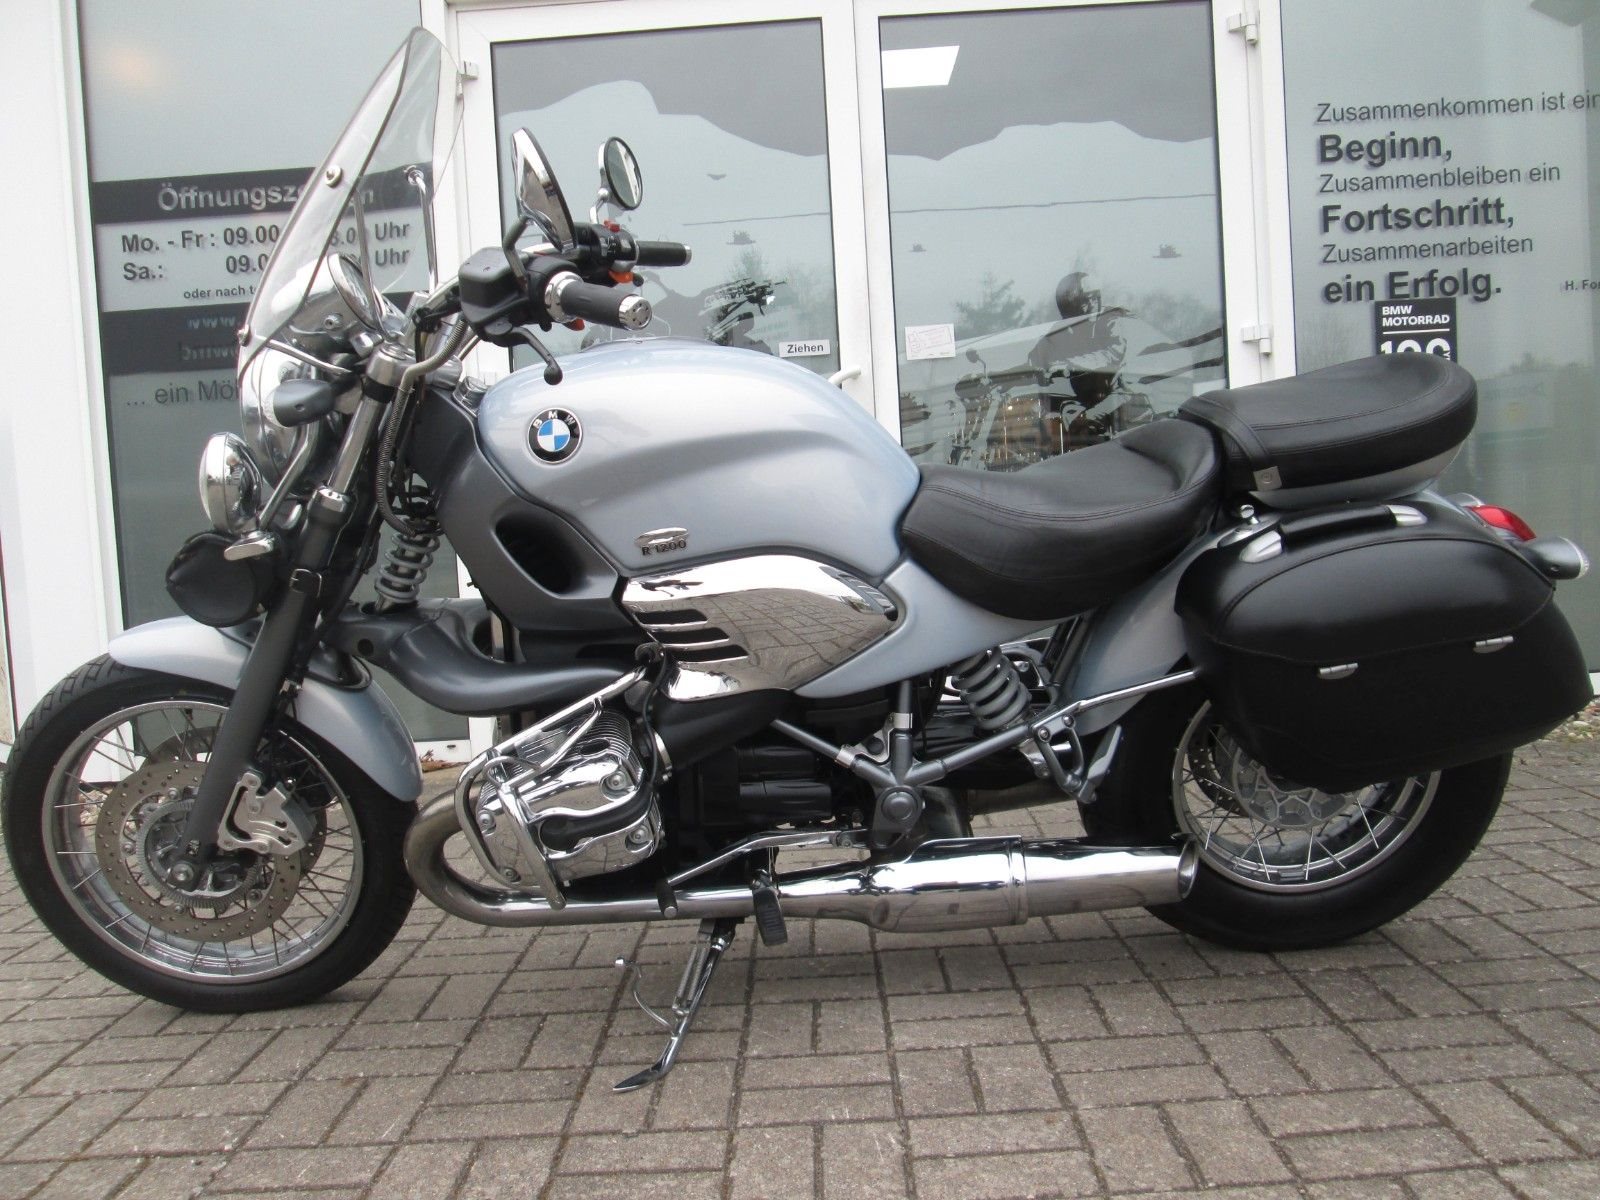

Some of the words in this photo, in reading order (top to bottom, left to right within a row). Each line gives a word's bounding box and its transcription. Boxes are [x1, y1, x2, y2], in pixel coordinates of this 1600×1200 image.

[1316, 97, 1534, 123] Zusammenkommen
[1541, 91, 1566, 111] ist
[1572, 89, 1600, 110] ein
[1319, 131, 1453, 168] Beginn,
[1319, 167, 1521, 194] Zusammenbleiben
[1529, 162, 1560, 184] ein
[1321, 196, 1515, 234] Fortschritt,
[121, 233, 160, 253] Mo.
[223, 224, 280, 246] 09.00
[375, 221, 410, 241] Uhr
[225, 253, 269, 274] 09.0
[375, 247, 410, 267] Uhr
[1322, 235, 1534, 264] Zusammenarbeiten
[183, 288, 212, 299] oder
[215, 285, 246, 298] nach
[1323, 273, 1376, 304] ein
[1388, 267, 1502, 303] Erfolg.
[1565, 280, 1578, 291] H.
[1382, 305, 1412, 316] BMW
[1382, 314, 1450, 327] MOTORRAD
[787, 343, 824, 355] Ziehen
[155, 382, 189, 404] ein
[532, 410, 576, 429] BMW
[641, 546, 651, 556] R
[654, 539, 687, 553] 1200
